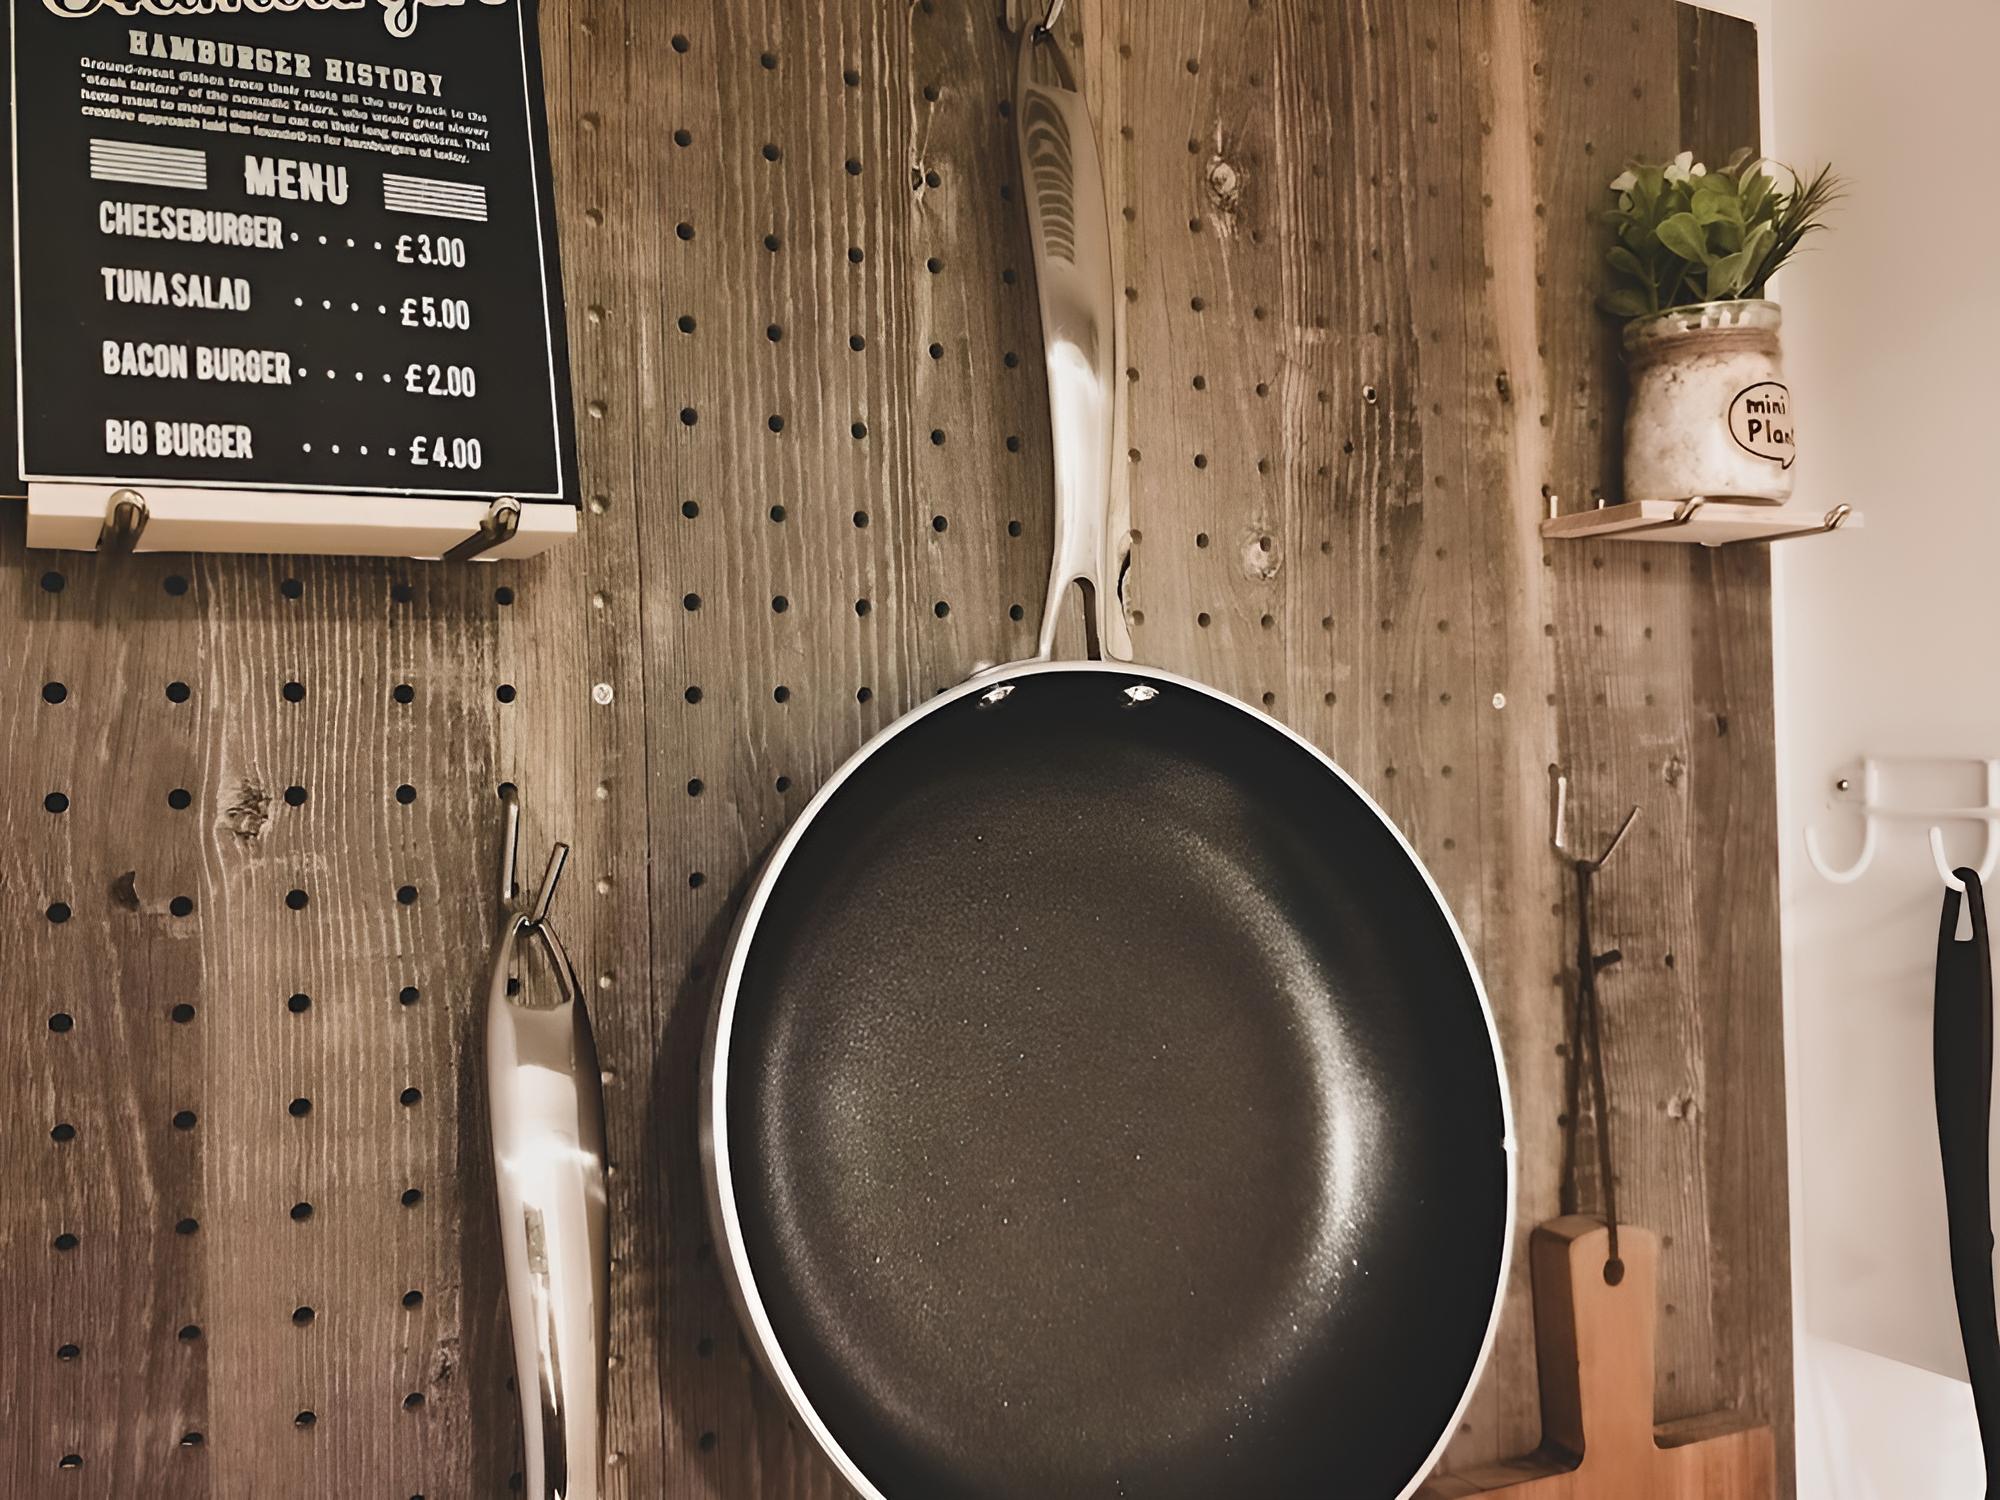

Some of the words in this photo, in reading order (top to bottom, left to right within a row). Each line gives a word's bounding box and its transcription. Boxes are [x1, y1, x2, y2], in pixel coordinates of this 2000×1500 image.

[129, 30, 311, 77] HAMBURGER
[325, 58, 442, 97] HISTORY
[160, 100, 175, 110] to
[177, 102, 216, 115] make
[218, 105, 227, 117] it
[230, 109, 270, 122] easier
[272, 113, 286, 124] to
[312, 120, 328, 129] on
[330, 120, 360, 133] their
[362, 124, 389, 139] long
[188, 88, 203, 98] of
[206, 90, 229, 102] the
[342, 109, 368, 120] who
[372, 113, 409, 126] would
[268, 83, 299, 96] their
[304, 89, 338, 101] roots
[362, 96, 384, 107] the
[388, 101, 413, 113] way
[416, 104, 447, 116] back
[451, 109, 463, 119] to
[81, 106, 135, 121] creative
[138, 113, 200, 128] approach
[202, 119, 227, 132] laid
[229, 122, 251, 134] the
[253, 125, 321, 143] foundation
[323, 134, 341, 146] for
[343, 137, 416, 156] hamburgers
[419, 148, 431, 158] of
[244, 155, 349, 205] MENU
[100, 201, 284, 249] CHEESEBURGER
[103, 341, 188, 379] BACON
[196, 346, 291, 384] BURGER
[1746, 394, 1786, 415] mini
[106, 419, 148, 455] BIG
[155, 421, 253, 459] BURGER
